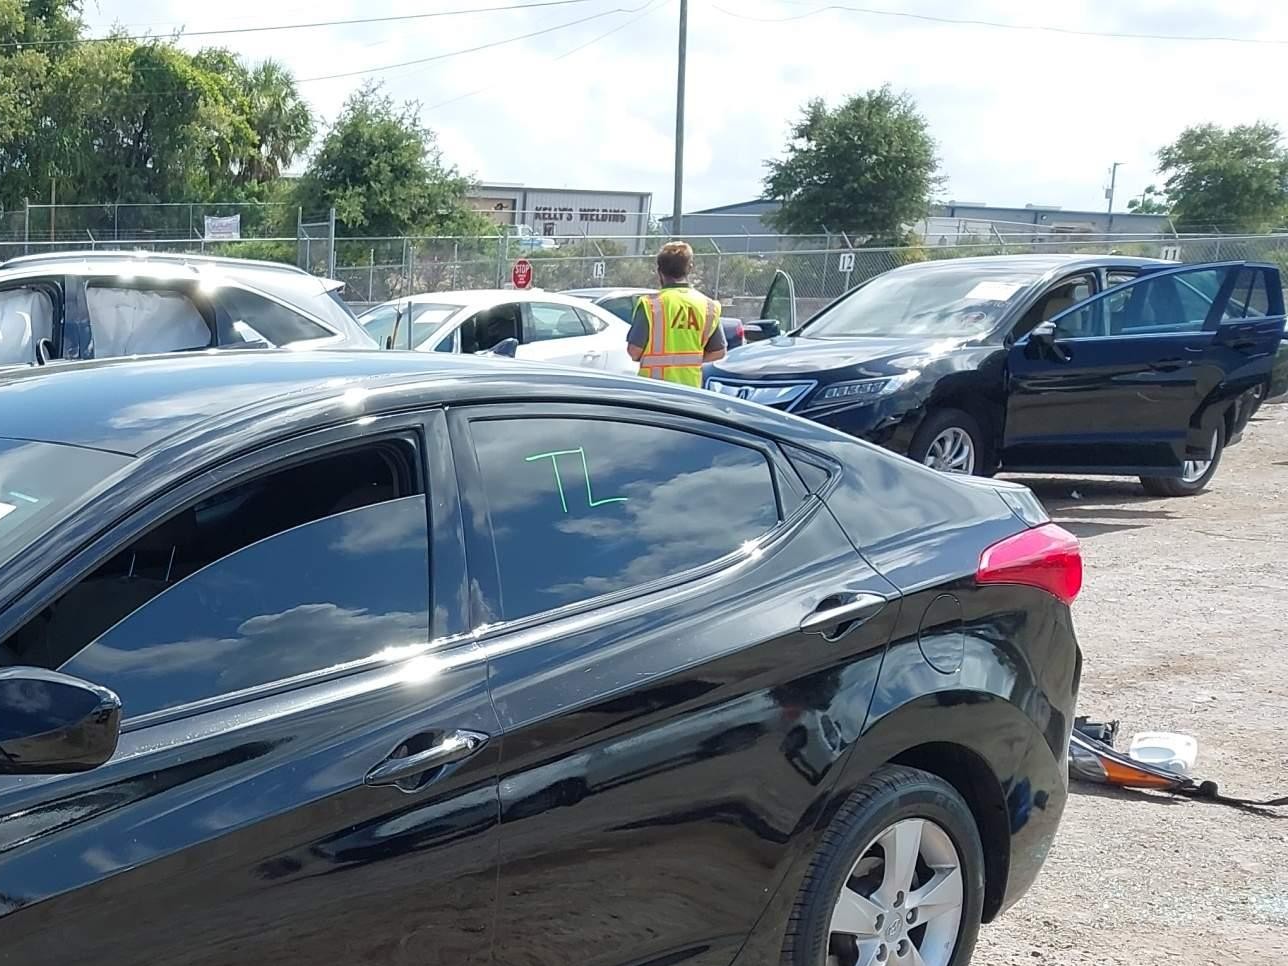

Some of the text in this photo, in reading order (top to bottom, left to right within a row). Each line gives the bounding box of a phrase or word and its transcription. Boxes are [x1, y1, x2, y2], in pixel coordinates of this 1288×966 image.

[534, 206, 627, 223] KELLY'S WELDING
[515, 264, 530, 274] STOP
[842, 254, 853, 270] 12
[525, 446, 629, 513] TL
